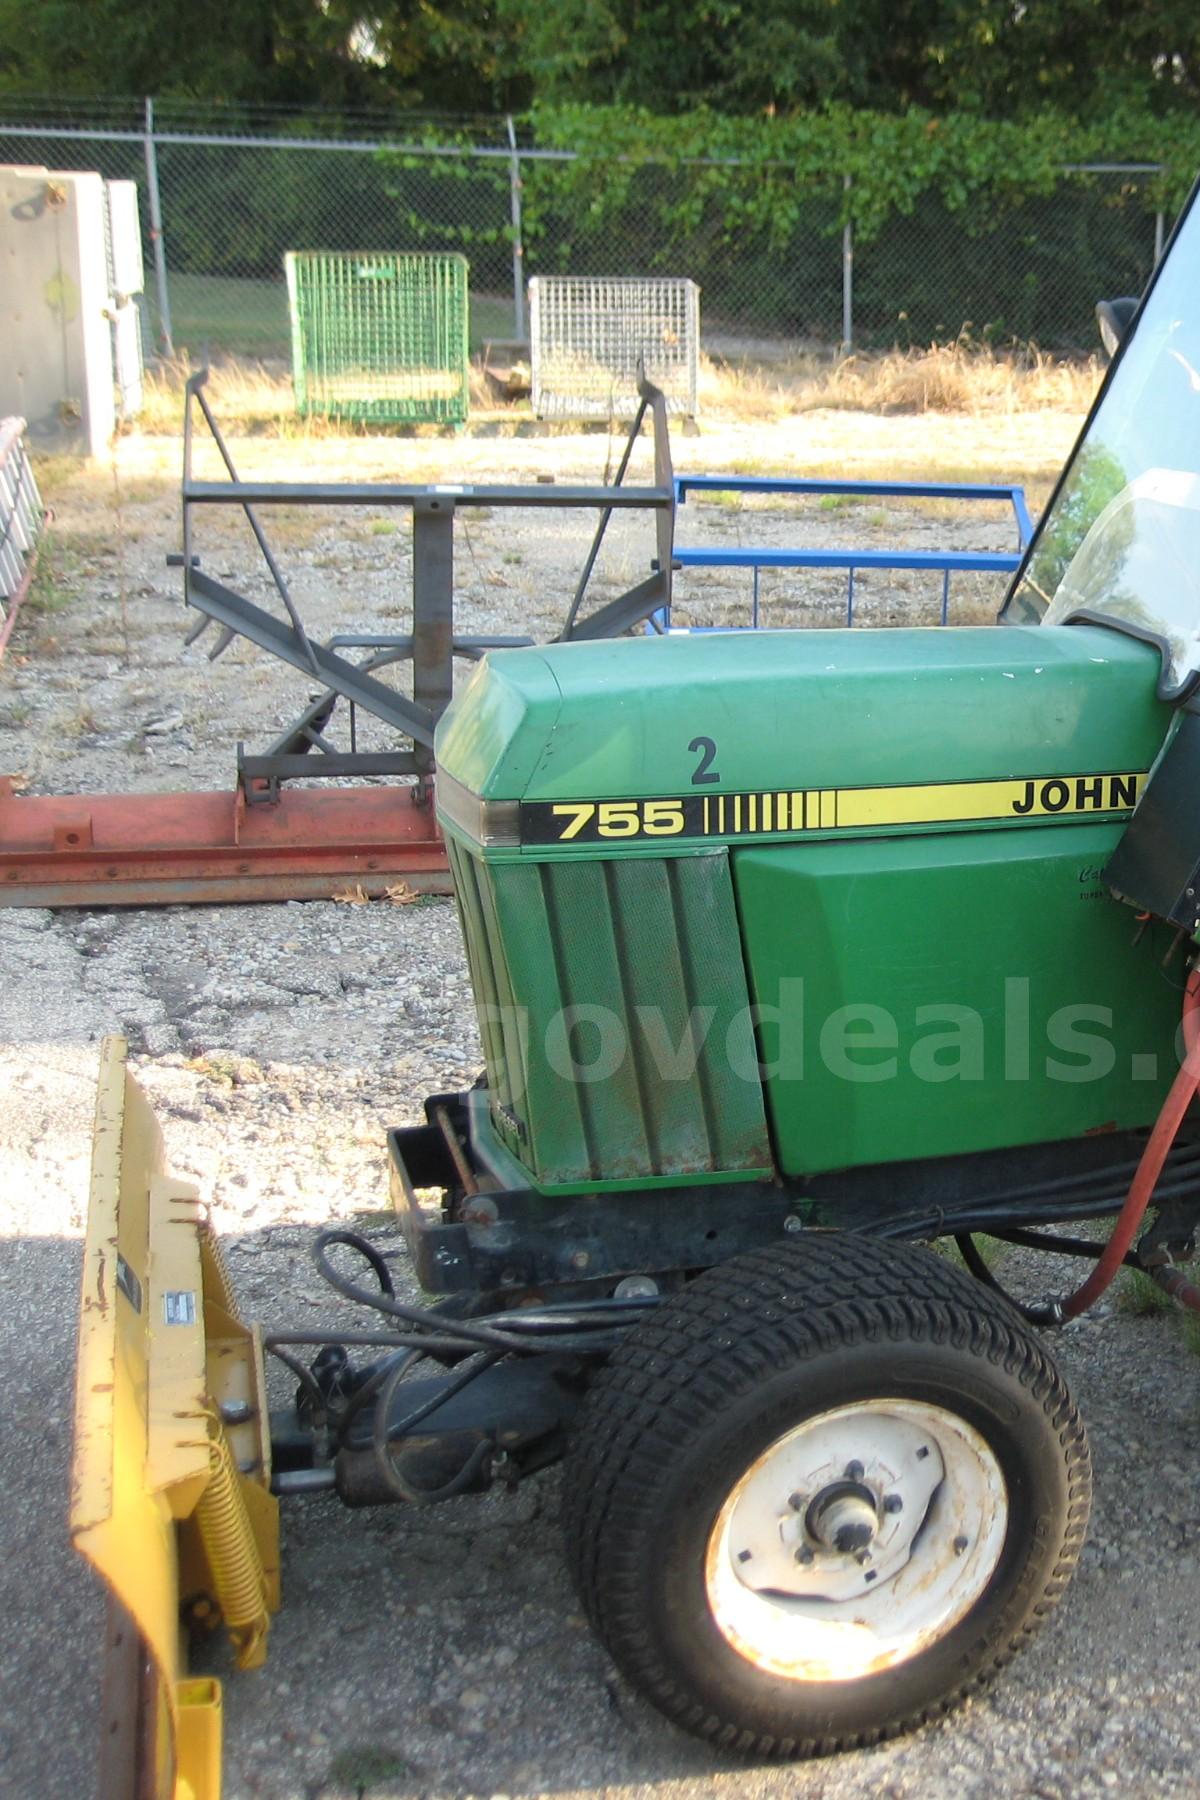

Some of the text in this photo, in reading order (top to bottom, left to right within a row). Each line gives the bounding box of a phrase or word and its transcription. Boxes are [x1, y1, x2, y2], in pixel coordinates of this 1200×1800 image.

[688, 736, 720, 785] 2
[1012, 776, 1137, 814] JOHN
[552, 800, 685, 839] 755
